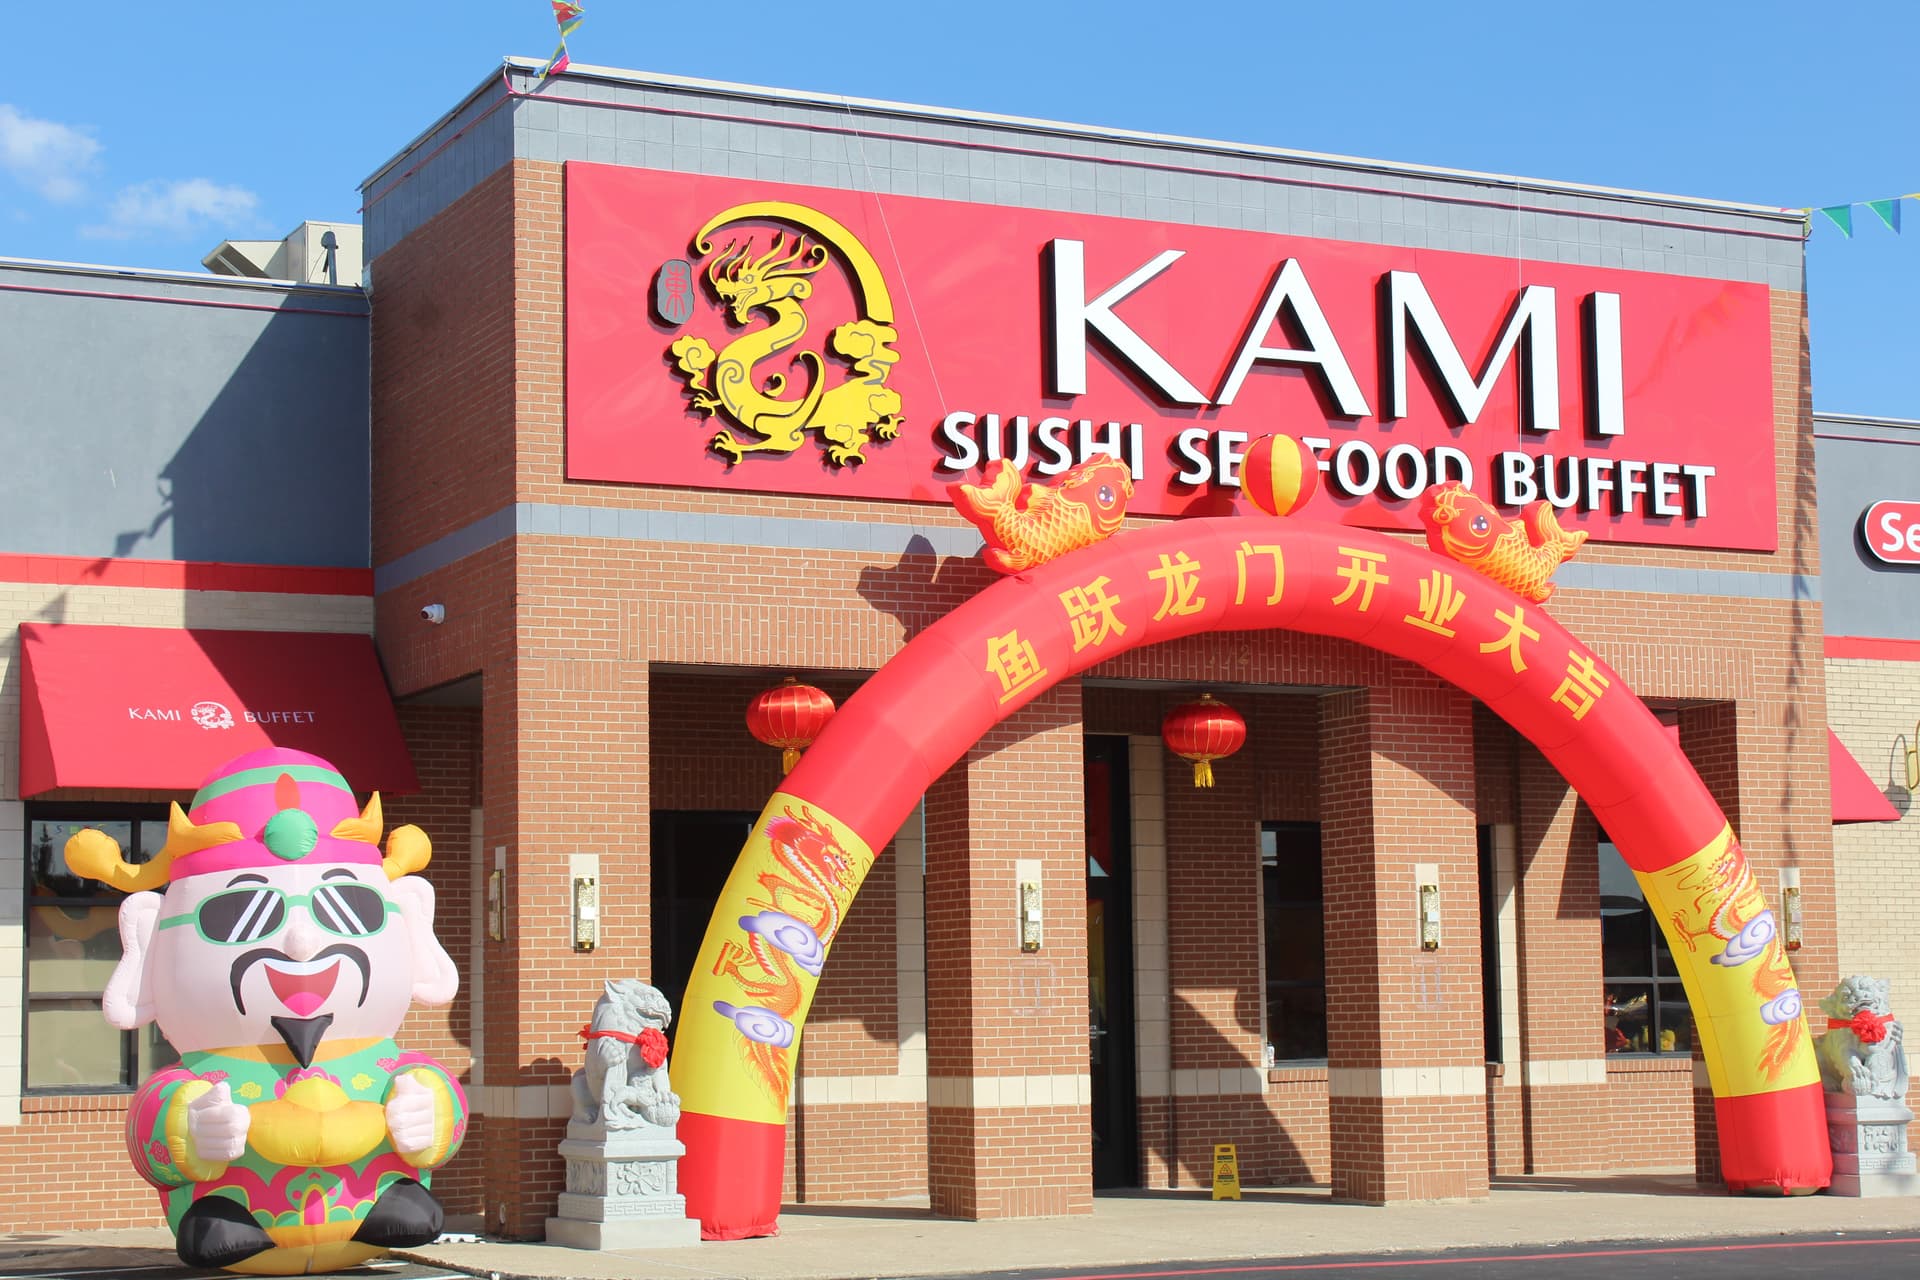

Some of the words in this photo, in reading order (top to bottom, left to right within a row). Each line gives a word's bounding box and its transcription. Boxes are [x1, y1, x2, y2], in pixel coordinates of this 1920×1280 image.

[1053, 238, 1626, 437] KAMI
[942, 411, 1144, 481] SUSHI
[1178, 427, 1475, 500] SEOOD
[1502, 451, 1716, 518] BUFFET
[128, 707, 181, 721] KAMI
[243, 711, 316, 723] BUFFET
